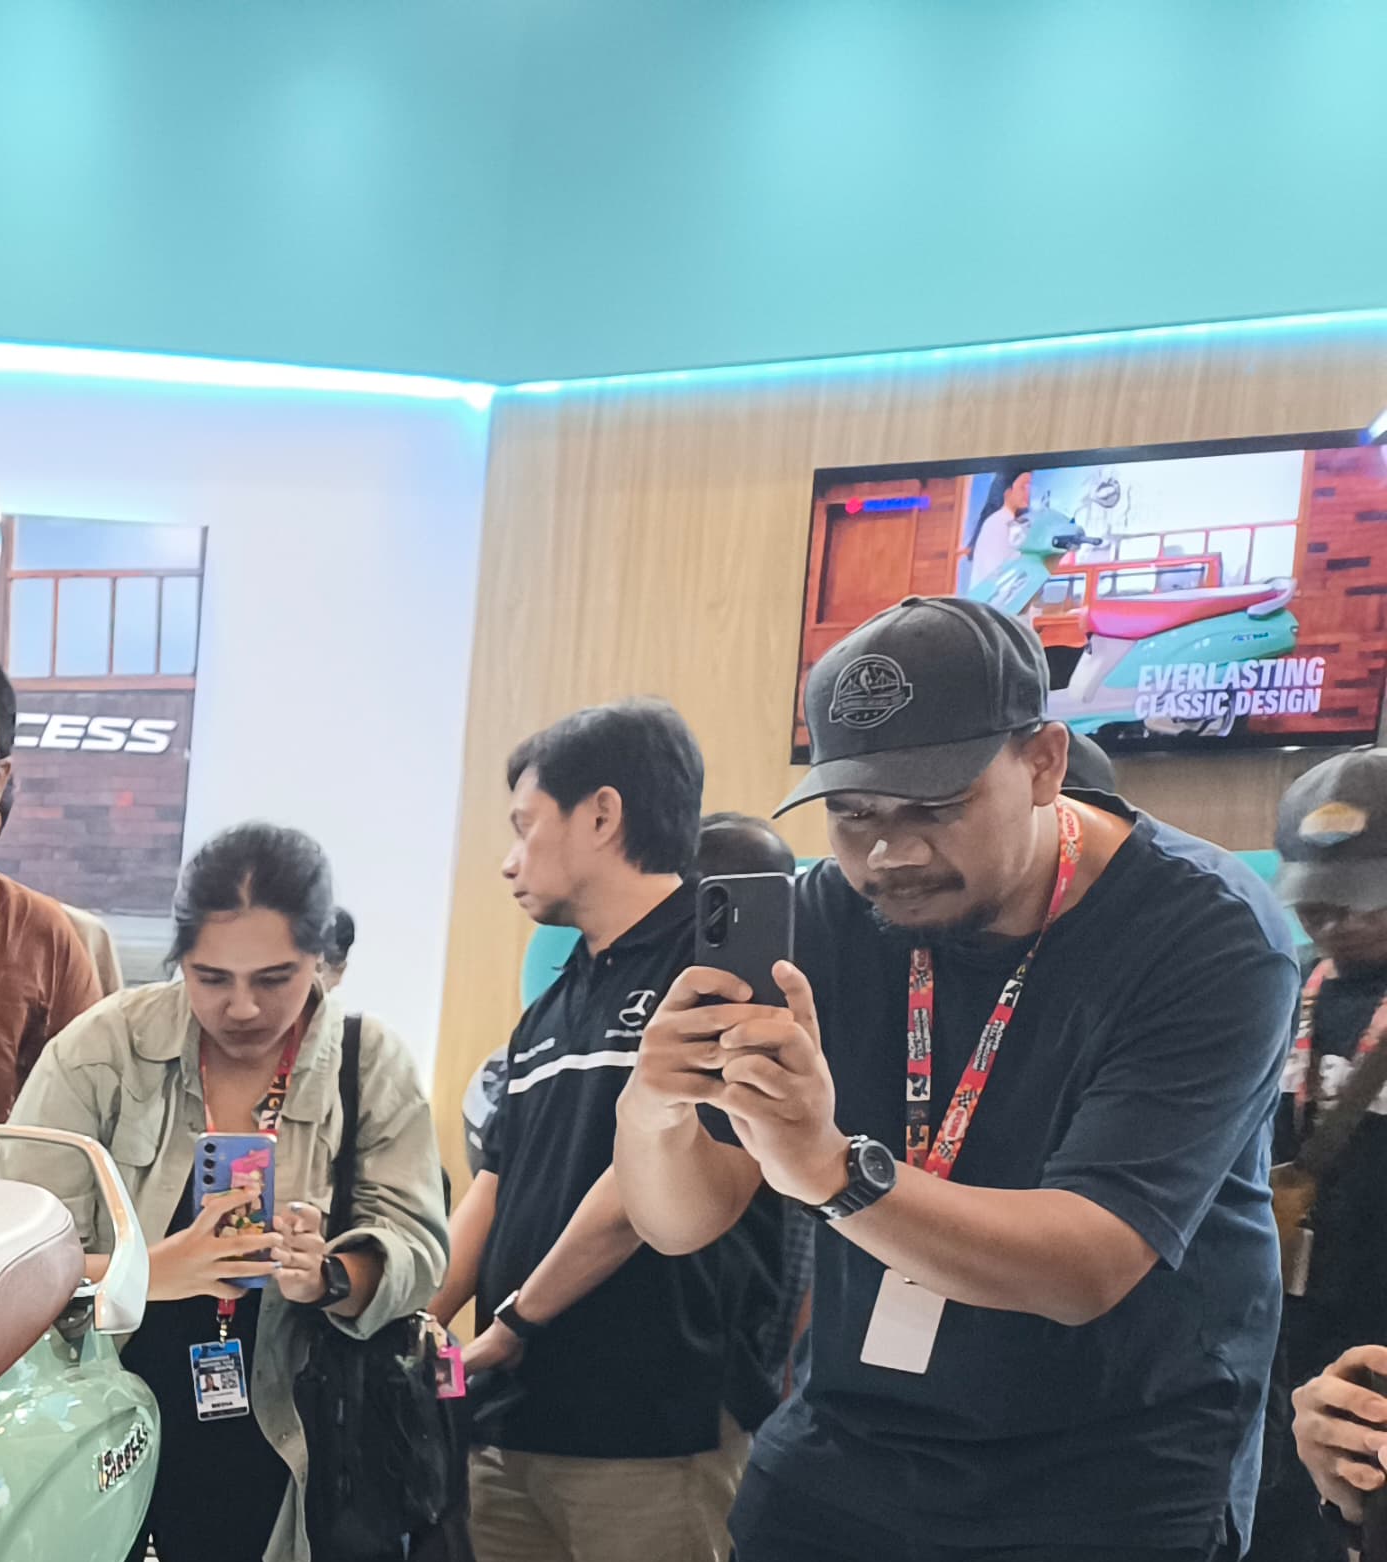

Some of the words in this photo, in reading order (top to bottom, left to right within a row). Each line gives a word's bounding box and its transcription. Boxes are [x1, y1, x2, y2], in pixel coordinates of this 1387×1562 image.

[1138, 656, 1326, 694] EVERLASTING
[1135, 692, 1230, 720] CLASSIC
[1234, 687, 1323, 716] DESIGN
[14, 712, 177, 753] CESS
